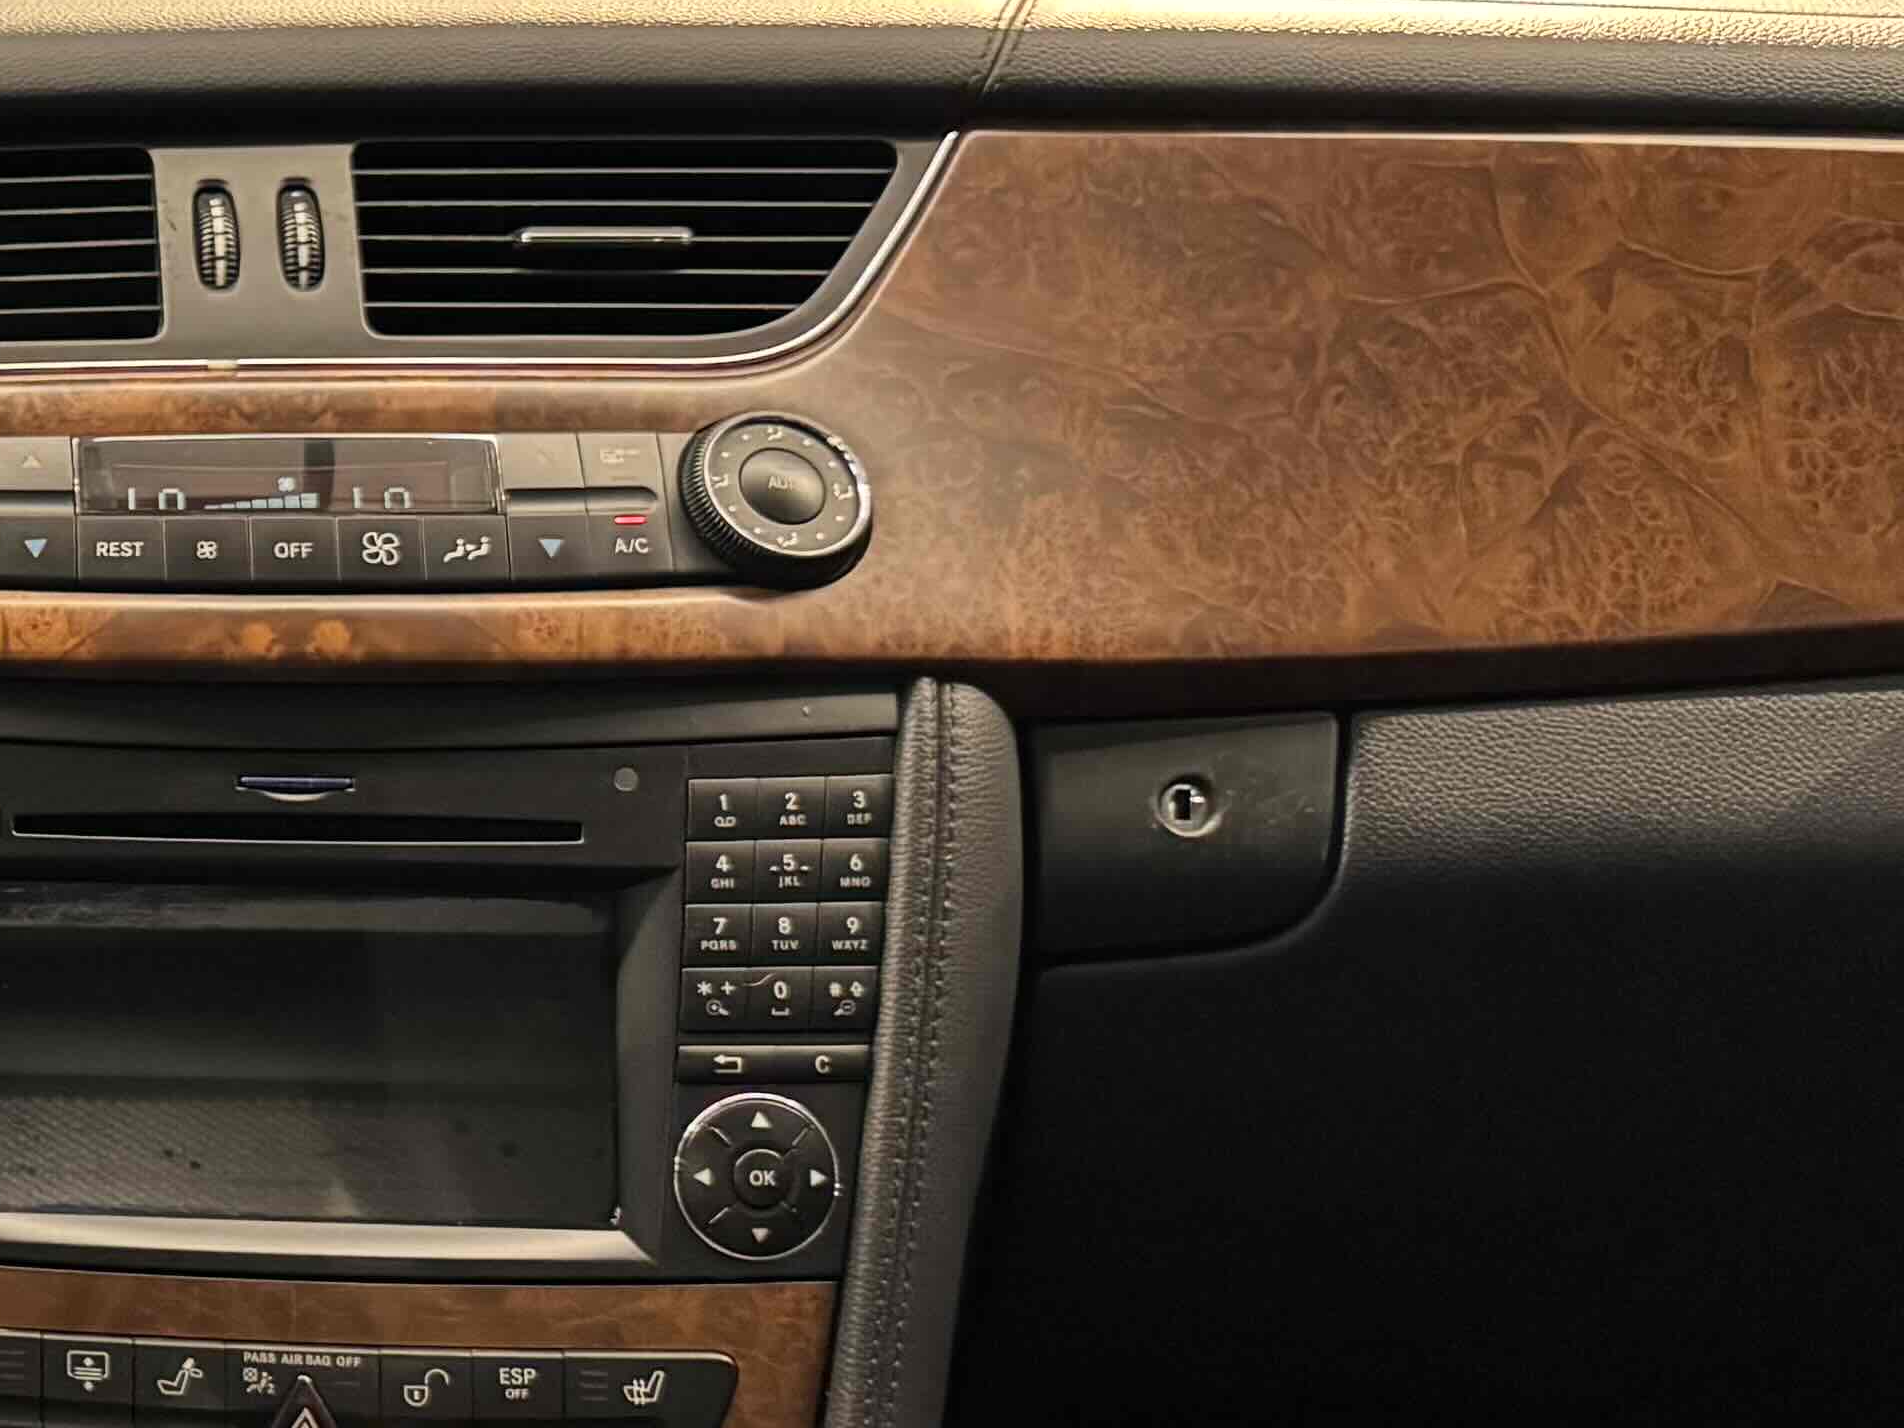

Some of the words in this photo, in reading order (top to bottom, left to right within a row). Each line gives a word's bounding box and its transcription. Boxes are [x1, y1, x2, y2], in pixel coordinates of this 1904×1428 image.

[96, 541, 145, 558] REST
[273, 541, 313, 559] OFF
[614, 537, 649, 554] A/C
[719, 793, 729, 811] 1
[784, 792, 800, 811] 2
[852, 790, 867, 809] 3
[779, 814, 807, 826] ABC
[715, 854, 732, 872] 4
[782, 853, 796, 872] 5
[849, 853, 864, 872] 6
[710, 877, 735, 889] GHI
[778, 876, 801, 888] JKL
[713, 917, 729, 935] 7
[778, 916, 792, 935] 8
[846, 916, 860, 934] 9
[771, 939, 800, 951] TUV
[773, 980, 789, 1000] 0
[814, 1054, 831, 1074] C
[748, 1170, 776, 1188] OK
[243, 1351, 276, 1364] PASS
[336, 1355, 361, 1368] OFF
[498, 1367, 537, 1386] ESP
[505, 1388, 529, 1400] OFF
